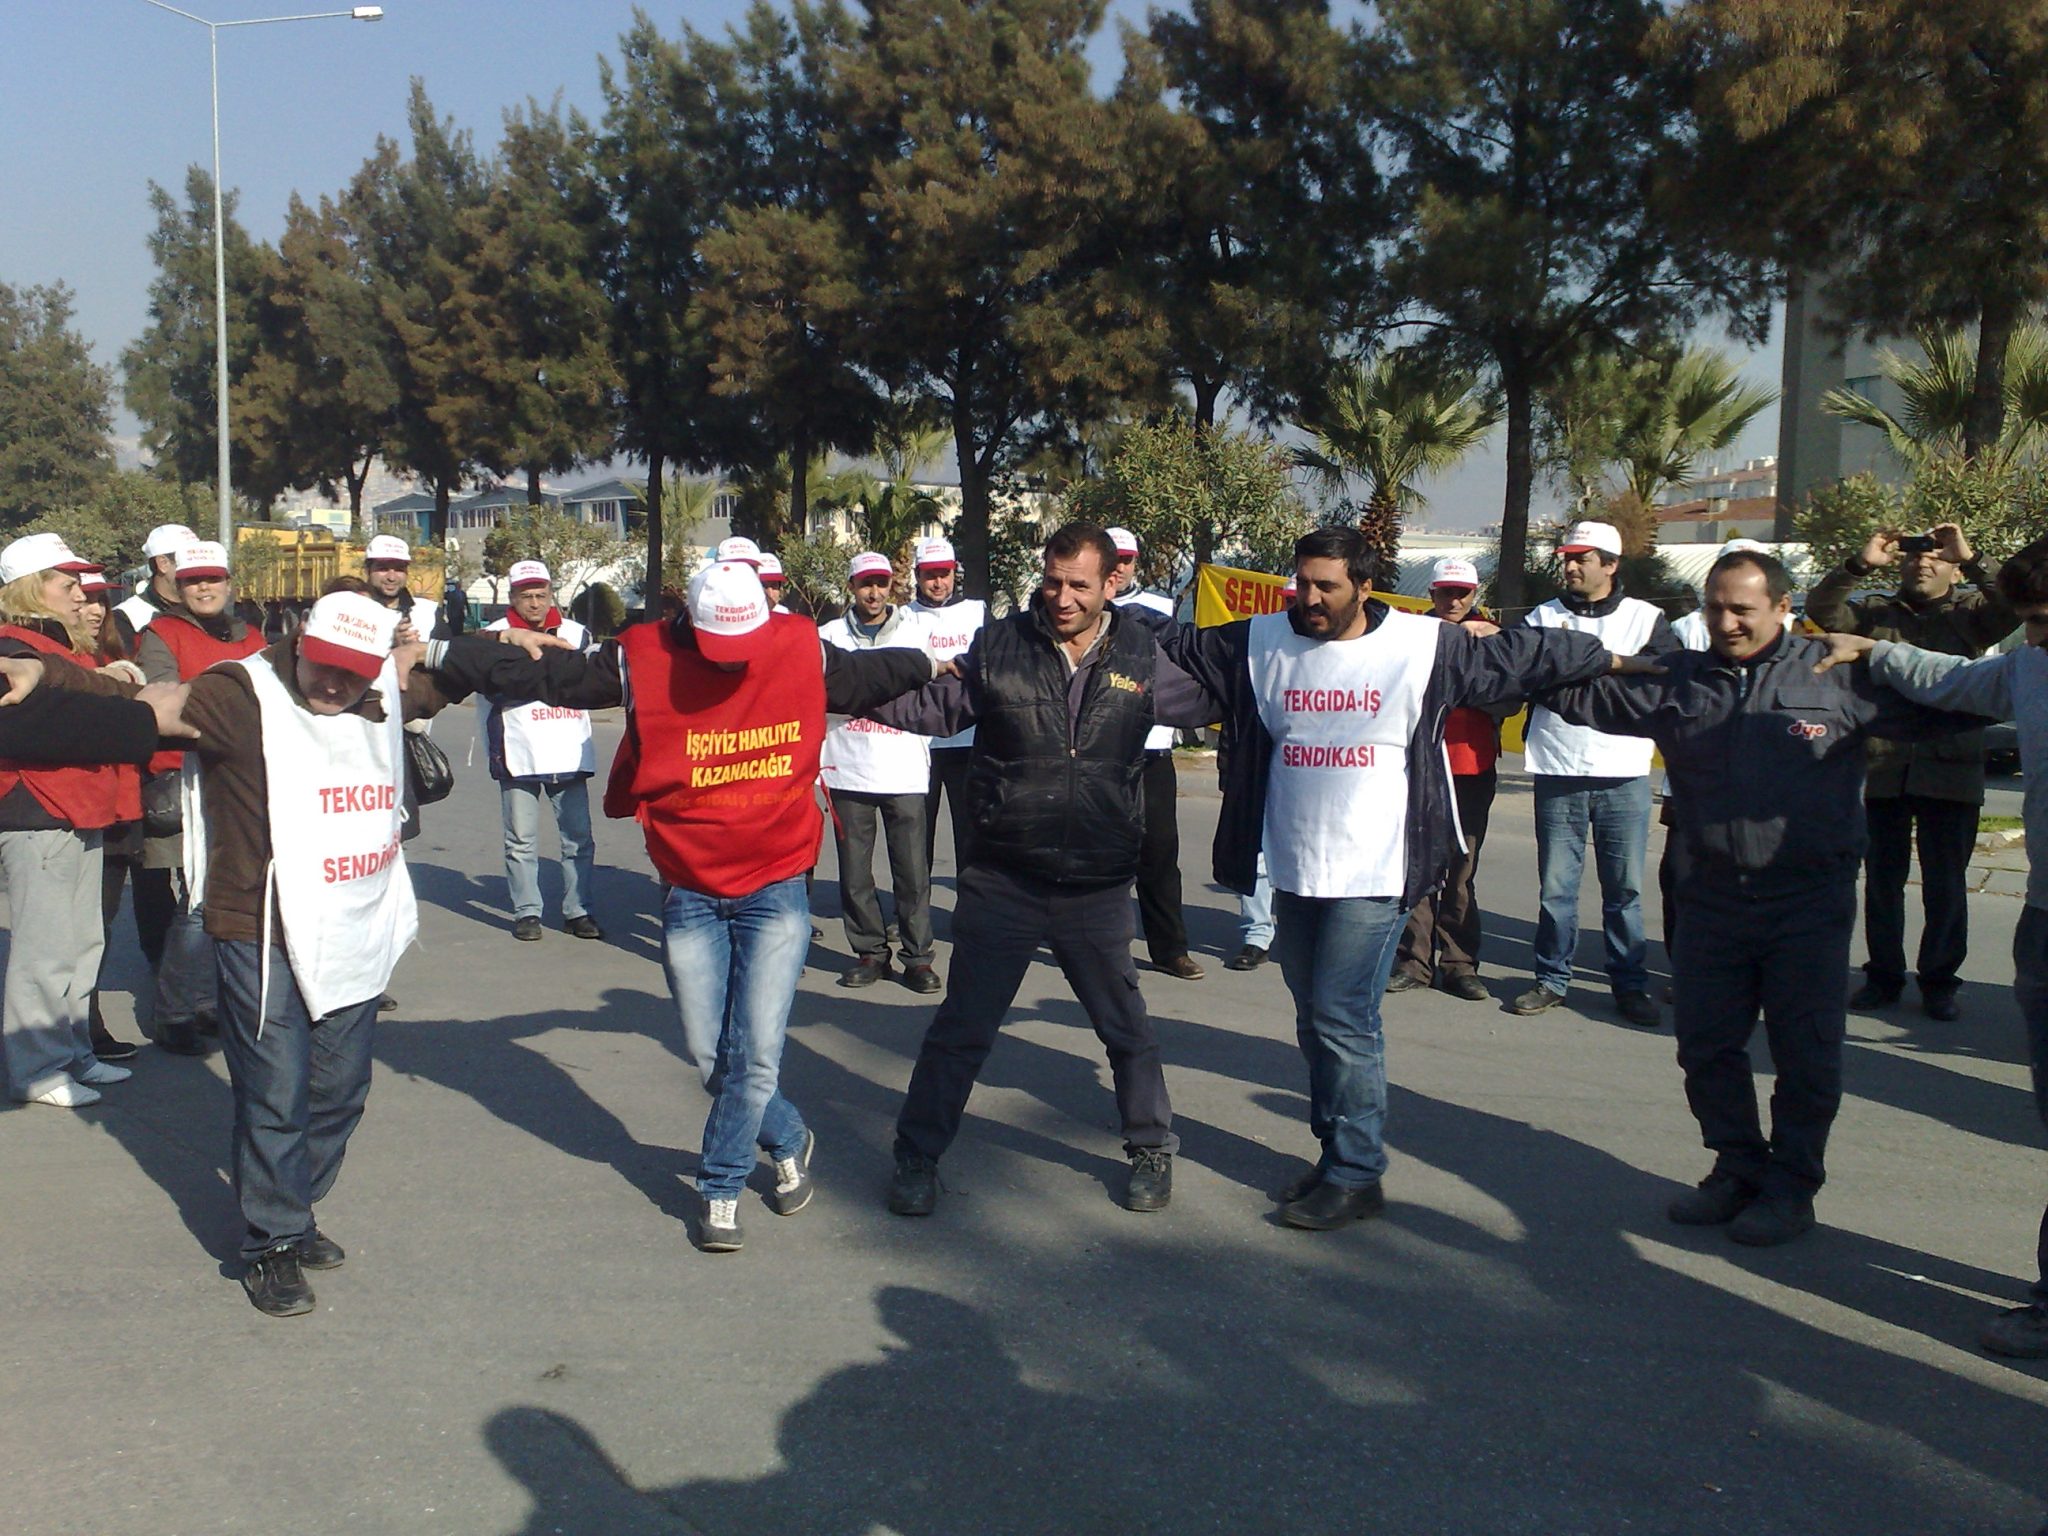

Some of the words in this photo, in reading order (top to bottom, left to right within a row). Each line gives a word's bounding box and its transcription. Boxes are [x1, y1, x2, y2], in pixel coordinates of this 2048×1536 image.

[1109, 672, 1138, 692] Yale
[1283, 683, 1382, 719] TEKGIDA-İŞ
[686, 728, 737, 760] İŞÇİYİZ
[738, 720, 802, 752] HAKLIYIZ
[1283, 741, 1375, 768] SENDİKASI
[690, 752, 793, 788] KAZANACAĞIZ
